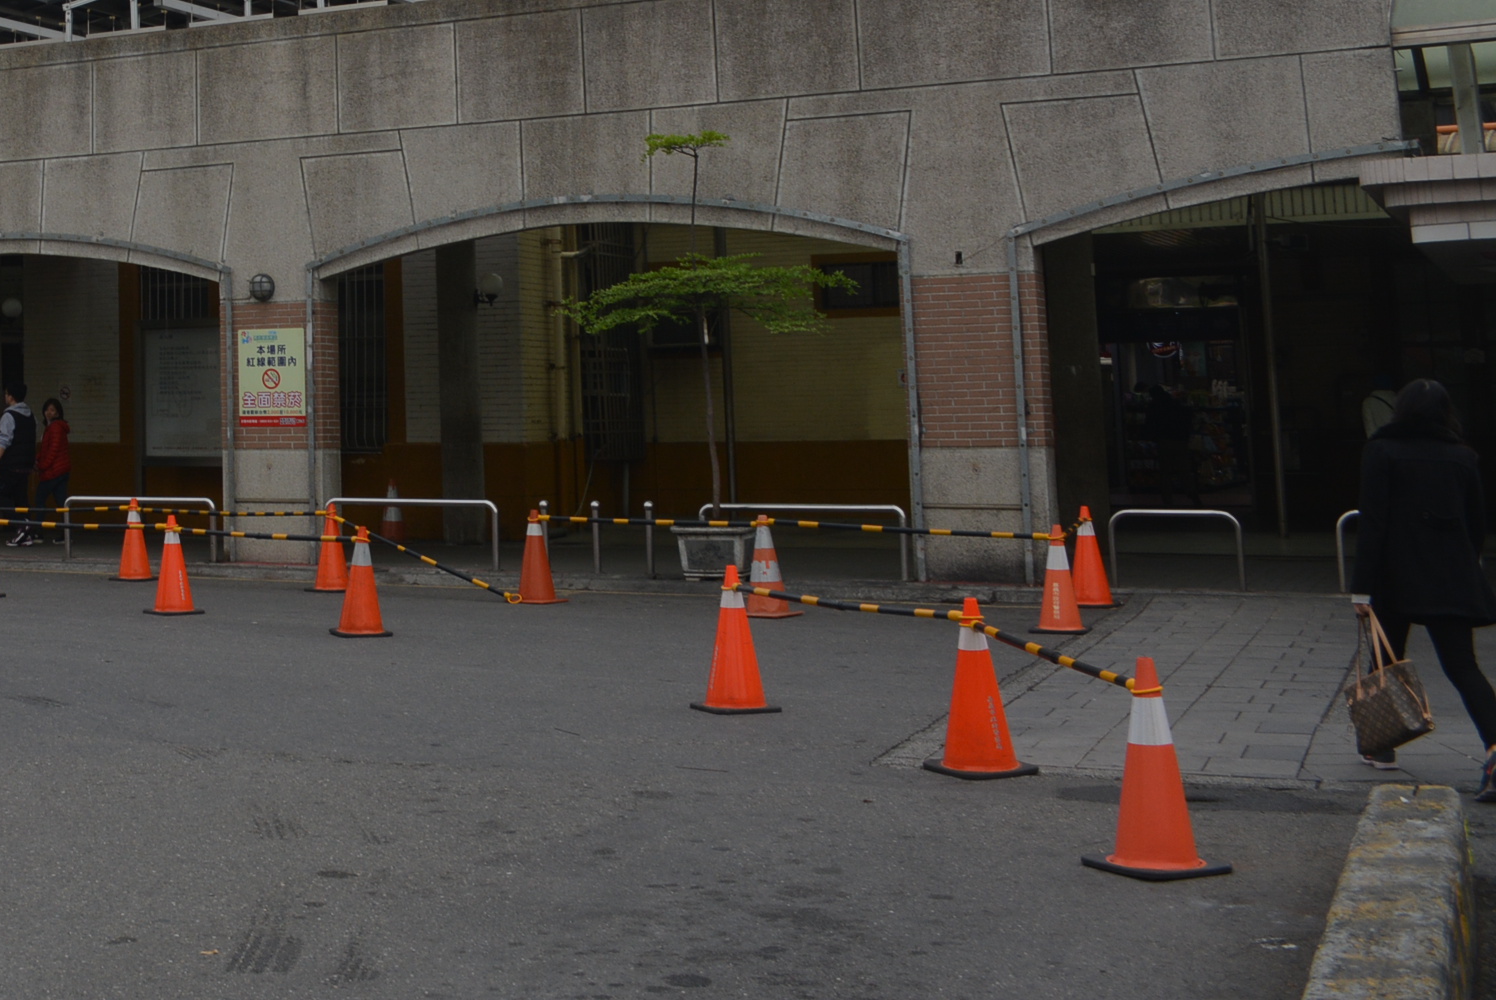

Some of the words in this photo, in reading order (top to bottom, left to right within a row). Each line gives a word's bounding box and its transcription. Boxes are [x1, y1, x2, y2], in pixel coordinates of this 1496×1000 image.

[256, 344, 287, 355] 本場所
[242, 391, 302, 408] 全面禁菸
